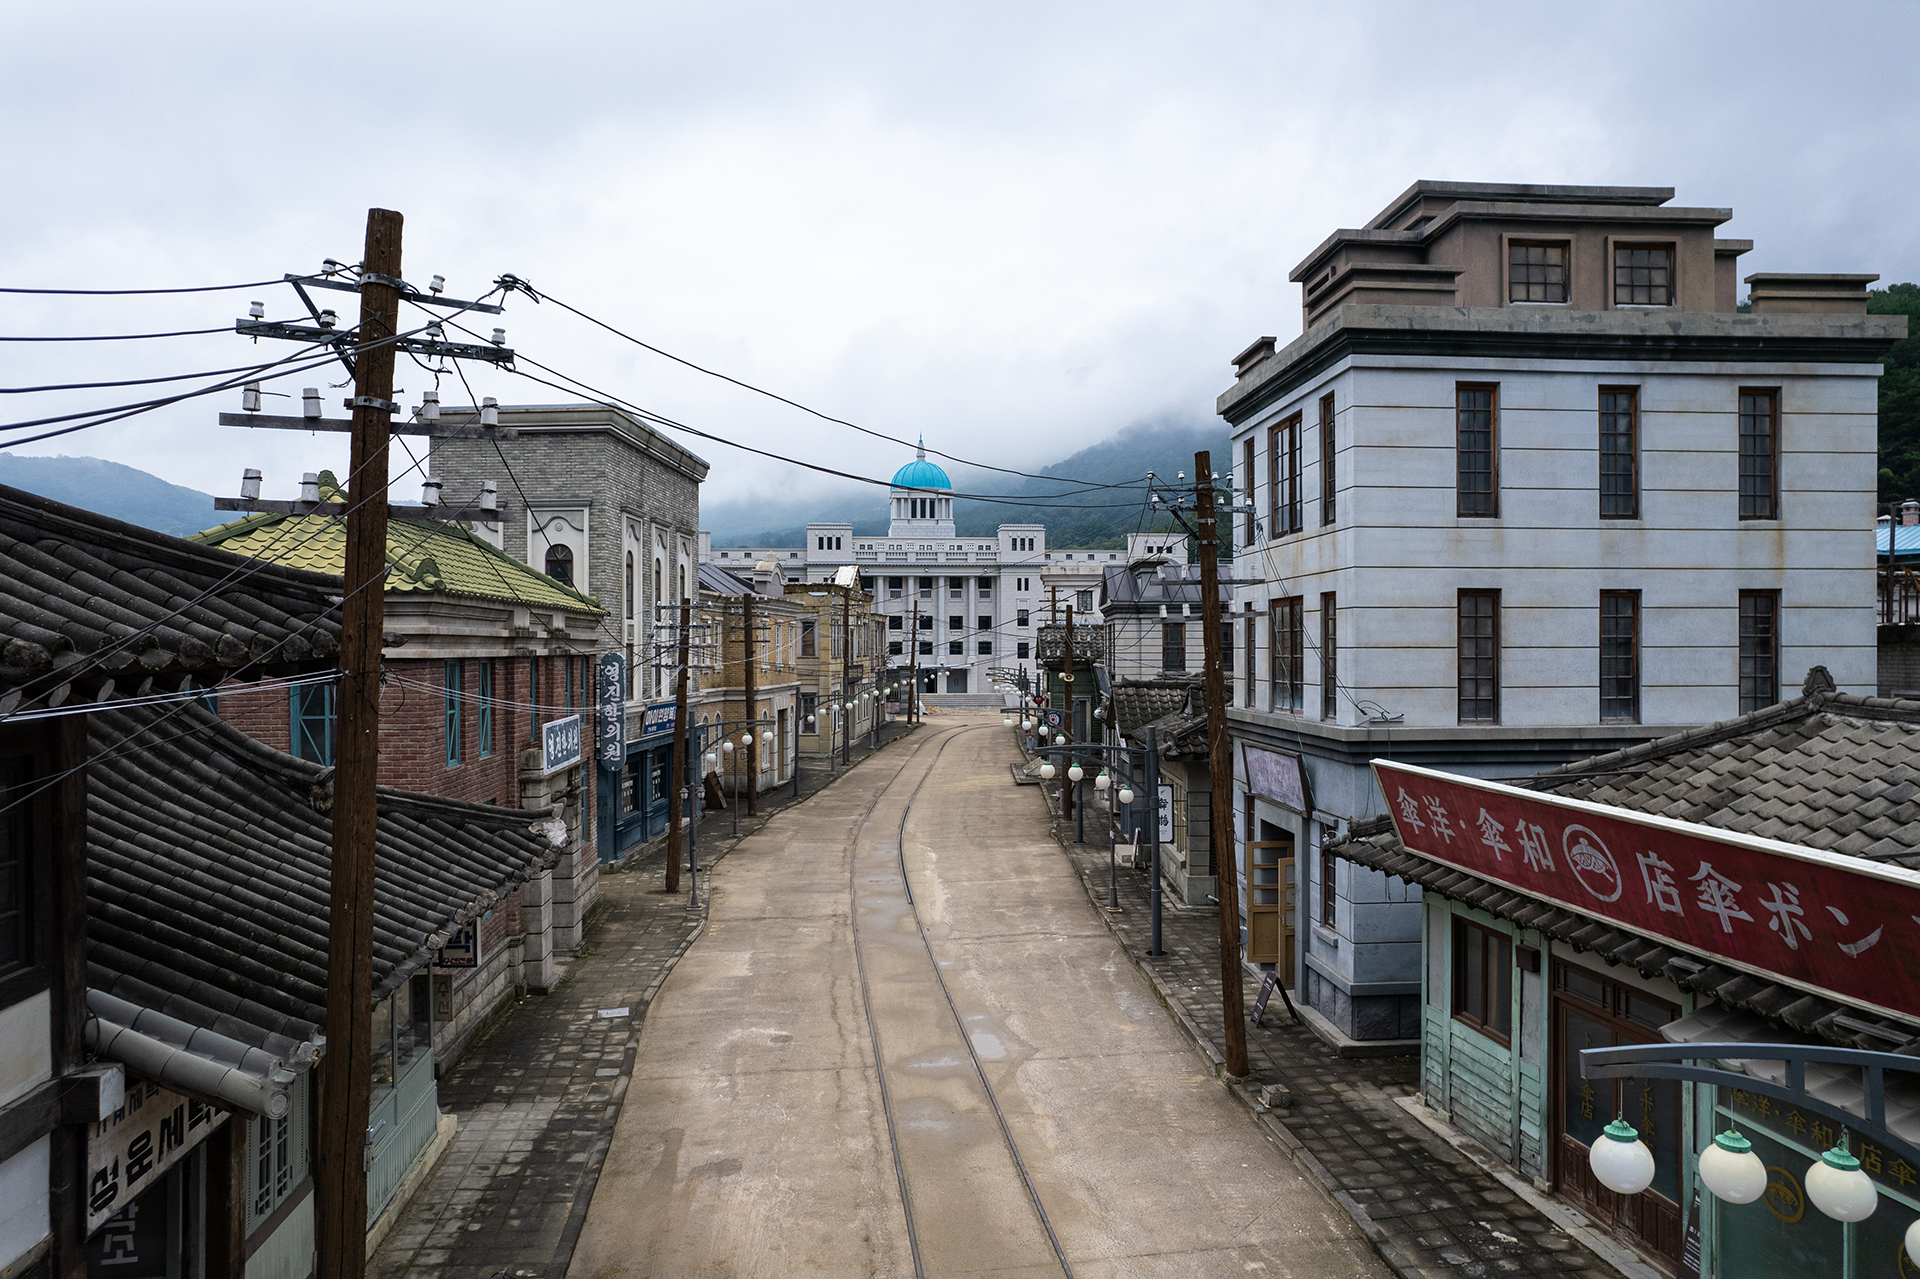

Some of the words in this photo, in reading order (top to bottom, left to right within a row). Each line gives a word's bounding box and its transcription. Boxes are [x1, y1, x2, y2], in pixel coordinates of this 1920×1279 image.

[548, 726, 578, 761] 영진한의원
[603, 661, 623, 762] 영진한의원
[437, 981, 449, 1015] 수선
[89, 1098, 224, 1217] 성운세탁
